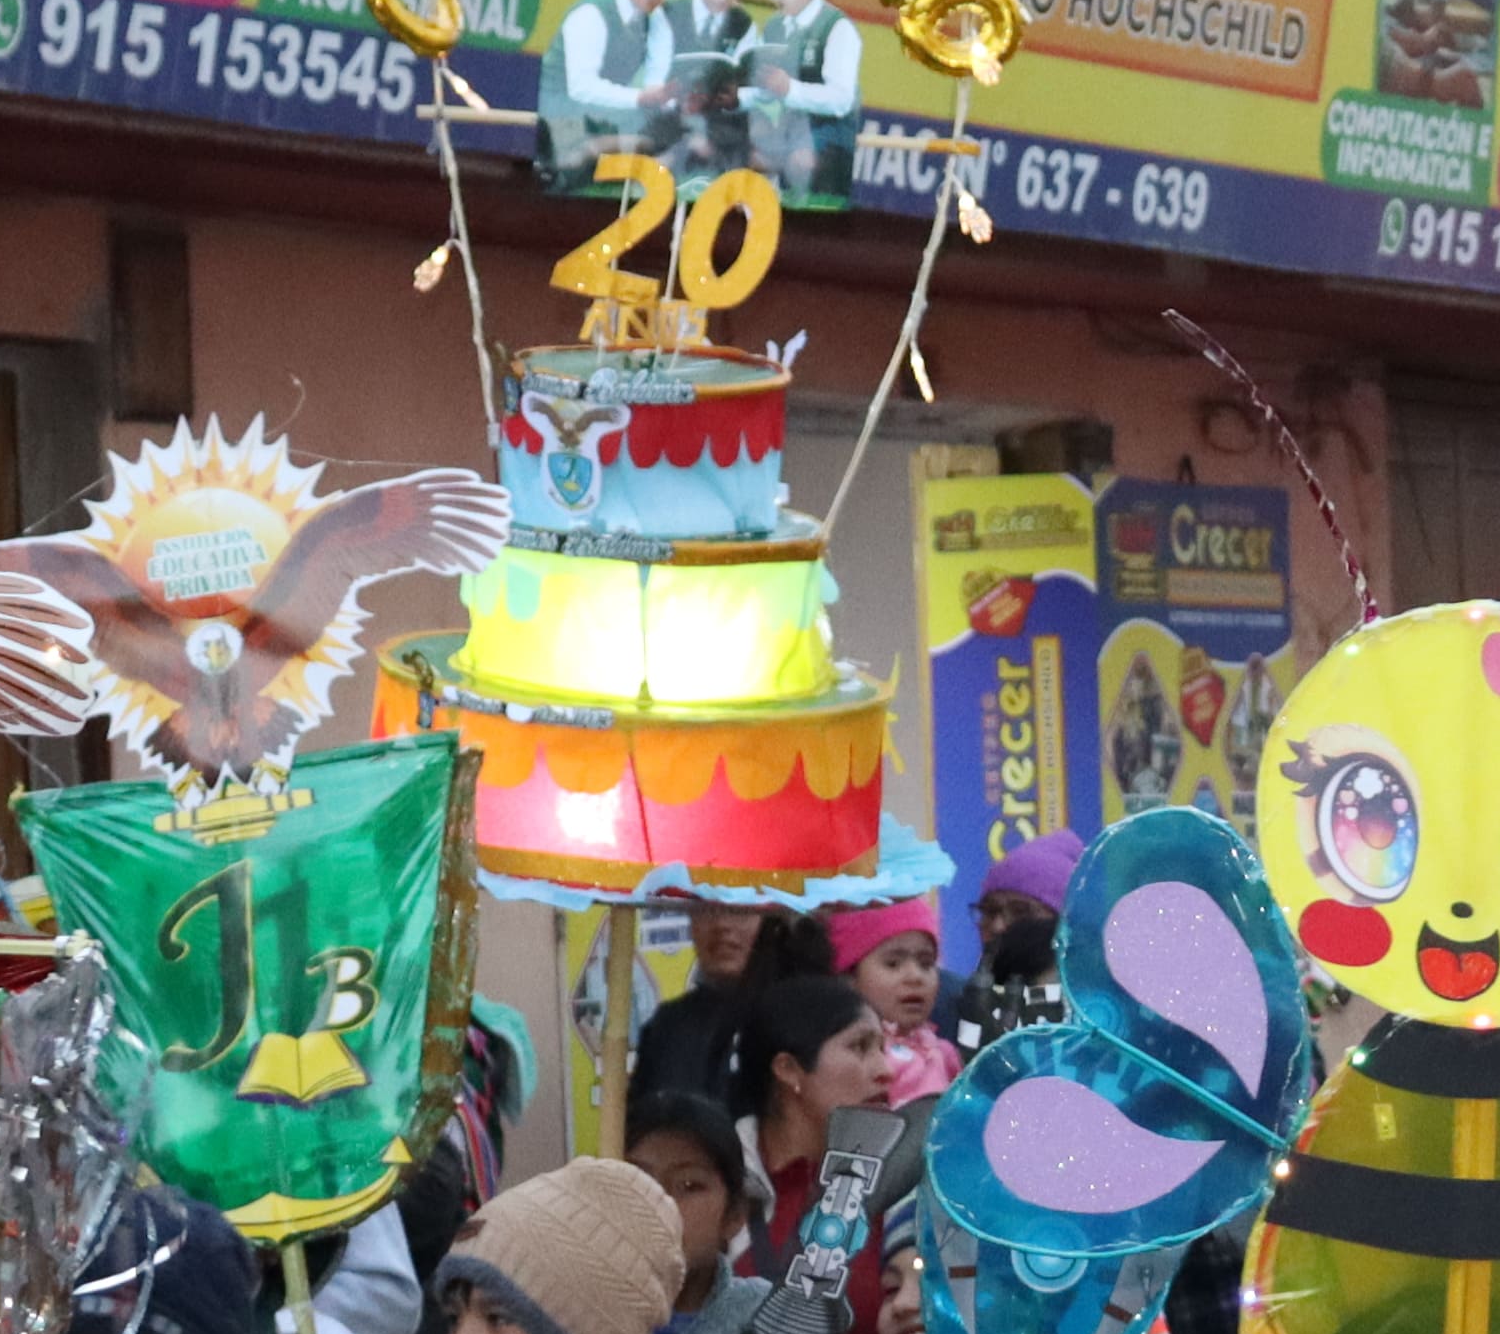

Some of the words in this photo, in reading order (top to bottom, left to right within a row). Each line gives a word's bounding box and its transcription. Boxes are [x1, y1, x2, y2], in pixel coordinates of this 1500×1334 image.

[188, 11, 417, 114] 153545
[1327, 97, 1473, 152] COMPUTACIÓN
[1477, 123, 1493, 158] E
[1017, 144, 1099, 216] 637
[1132, 162, 1210, 233] 639
[550, 153, 783, 309] 20
[1410, 206, 1483, 266] 915
[148, 541, 269, 580] EDUCATIVA
[1170, 503, 1273, 569] Crecer
[163, 570, 256, 601] PRIVADA
